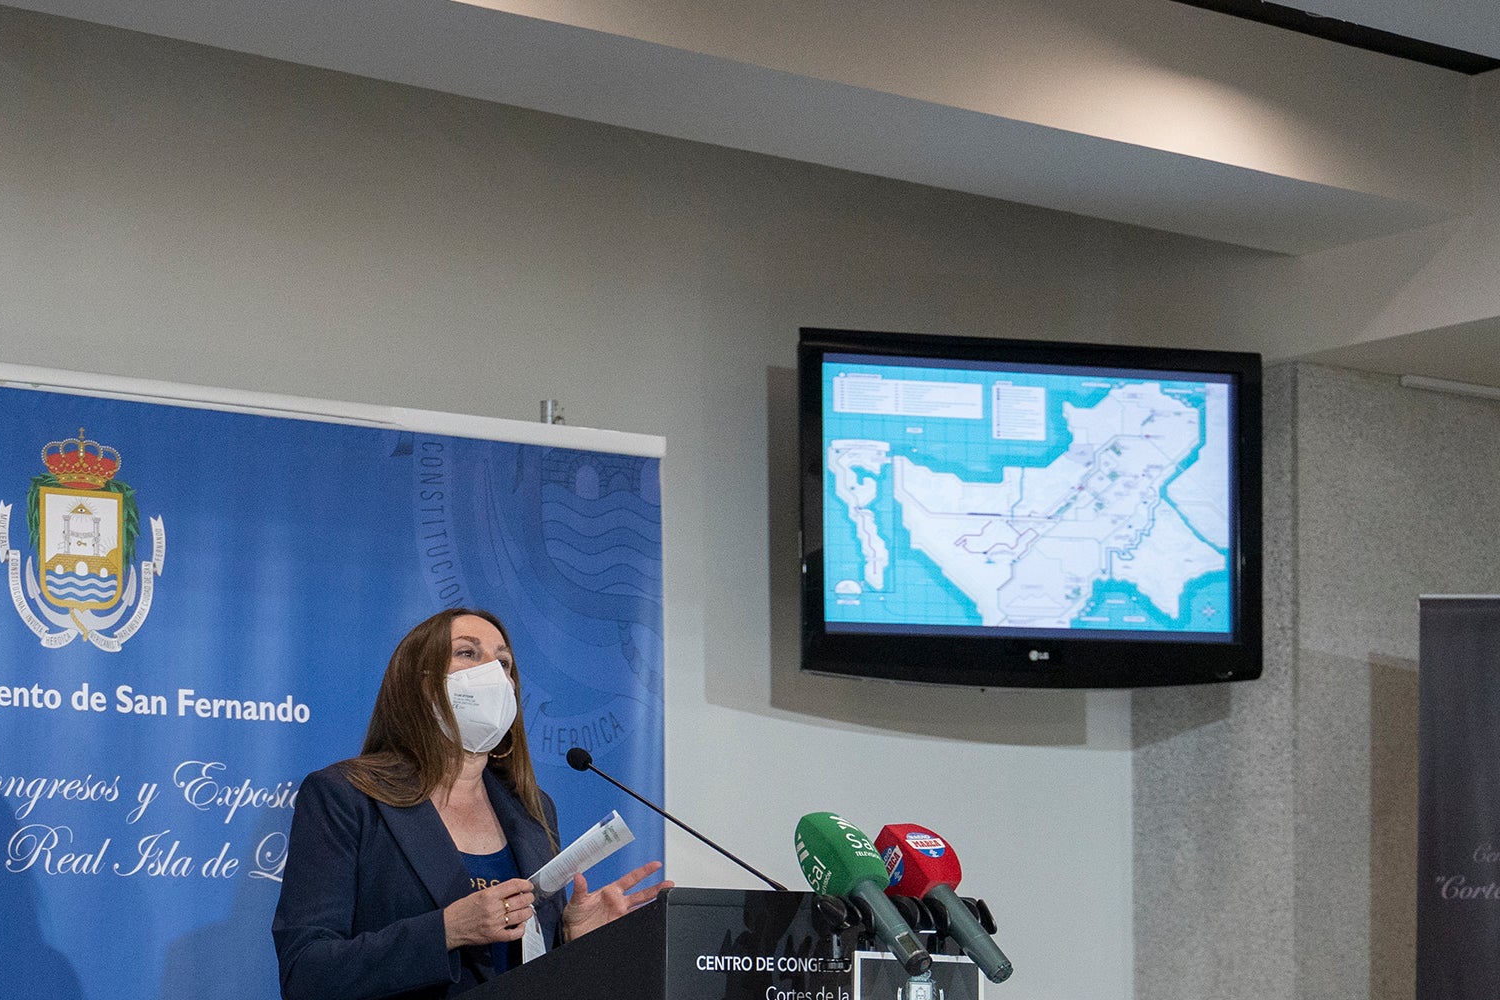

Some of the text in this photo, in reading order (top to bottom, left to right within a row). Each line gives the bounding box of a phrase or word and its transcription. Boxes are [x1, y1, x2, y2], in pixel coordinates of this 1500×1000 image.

[72, 680, 107, 713] de
[116, 685, 168, 717] San
[178, 689, 311, 724] Fernando
[126, 781, 160, 824] y
[6, 823, 112, 876] Real
[114, 829, 195, 879] Isla
[203, 843, 239, 879] de
[912, 839, 942, 848] MARCA
[886, 851, 901, 875] ARCA
[696, 955, 852, 973] CENTRO DE CONG
